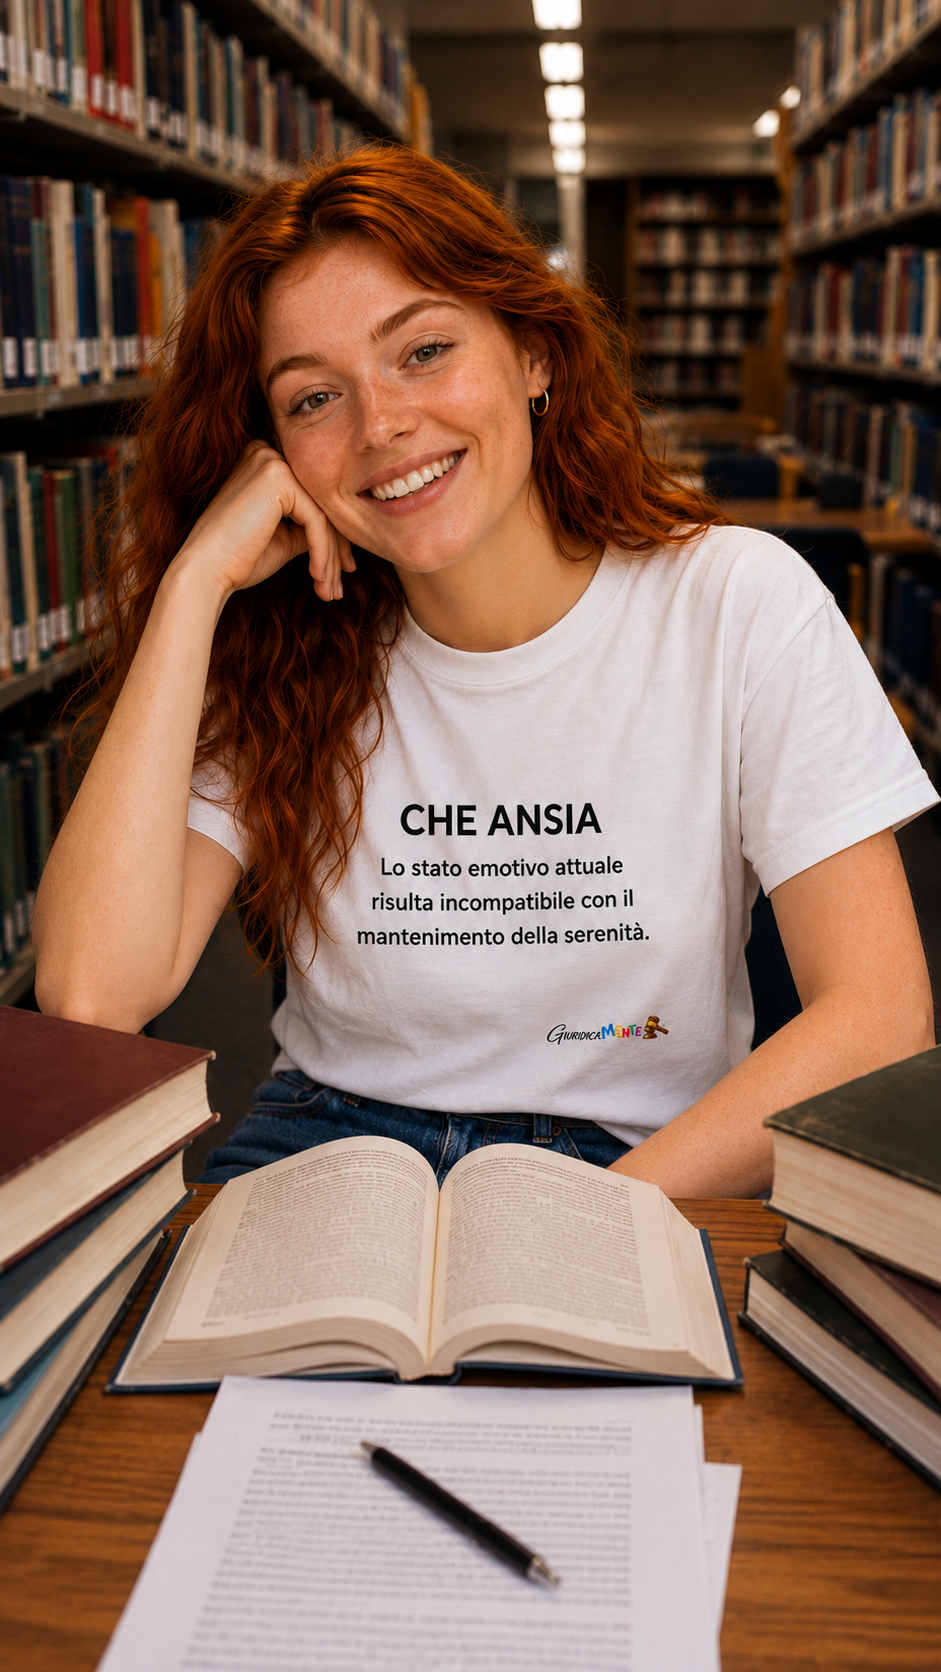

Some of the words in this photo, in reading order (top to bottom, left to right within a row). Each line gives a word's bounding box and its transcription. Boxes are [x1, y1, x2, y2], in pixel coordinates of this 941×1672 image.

[401, 804, 476, 836] CHE
[488, 803, 601, 835] ANSIA
[382, 858, 405, 876] Lo
[412, 860, 461, 876] stato
[468, 858, 549, 876] emotivo
[556, 856, 623, 875] attuale
[373, 892, 433, 911] risulta
[441, 891, 574, 915] incompatibile
[582, 895, 616, 908] con
[624, 889, 633, 906] il
[358, 928, 504, 945] mantenimento
[512, 926, 557, 944] della
[565, 922, 649, 943] serenità.
